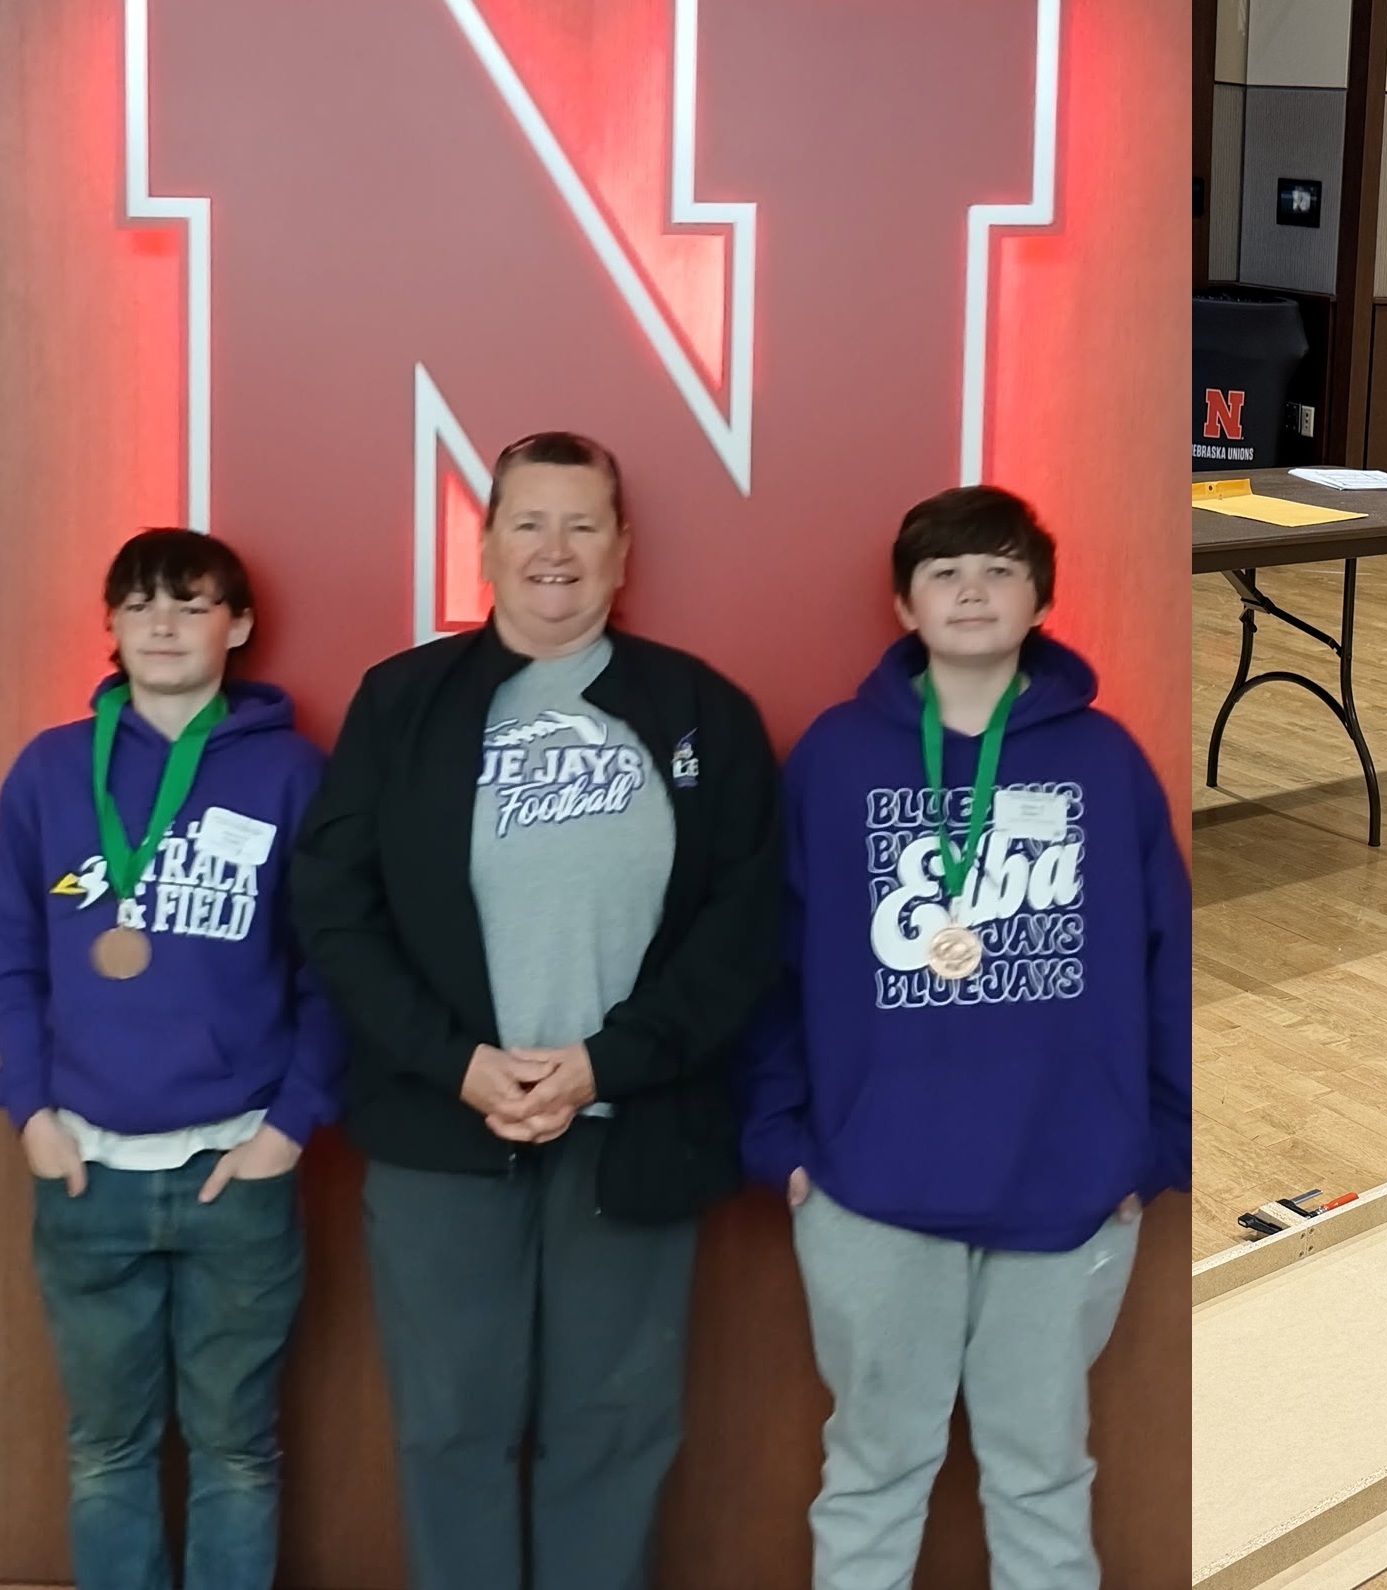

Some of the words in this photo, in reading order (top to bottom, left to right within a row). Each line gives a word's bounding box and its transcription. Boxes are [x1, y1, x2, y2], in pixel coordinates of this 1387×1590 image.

[1203, 388, 1245, 440] N
[1227, 447, 1254, 461] UNIONS
[533, 745, 645, 790] JAYS
[497, 773, 634, 838] Football
[151, 884, 256, 941] FIELD
